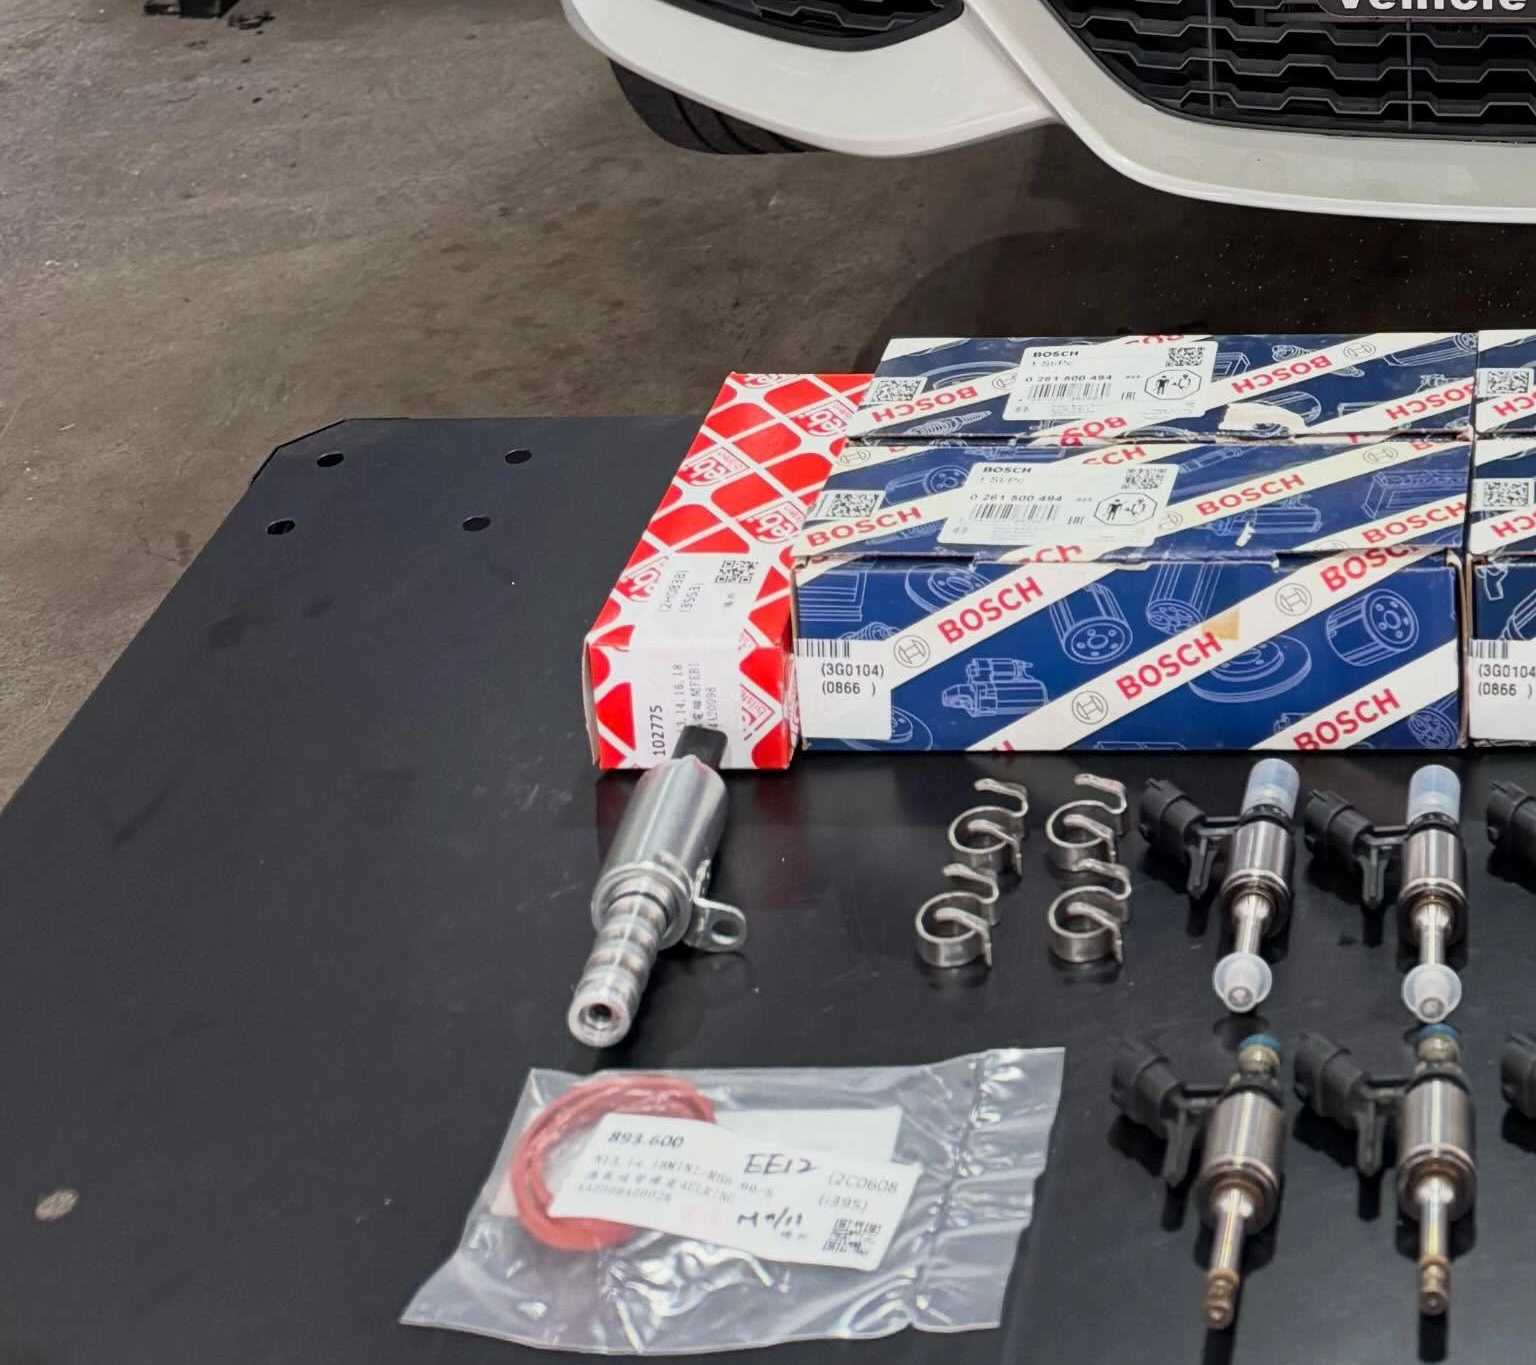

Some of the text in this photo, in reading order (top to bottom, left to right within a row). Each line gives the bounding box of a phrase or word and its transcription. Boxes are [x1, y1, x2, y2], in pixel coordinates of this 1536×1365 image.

[1033, 350, 1079, 358] BOSCH
[1232, 355, 1333, 395] BOSCH
[872, 385, 979, 423] BOSCH
[983, 466, 1032, 474] BOSCH
[1196, 473, 1305, 517] BOSCH
[807, 506, 922, 548] BOSCH
[937, 576, 1044, 645] BOSCH
[821, 662, 886, 678] (3G0104)
[1115, 631, 1224, 701] BOSCH
[822, 681, 861, 696] (0866
[649, 704, 666, 757] 102775
[1293, 687, 1401, 751] BOSCH
[607, 1130, 685, 1149] 893.600
